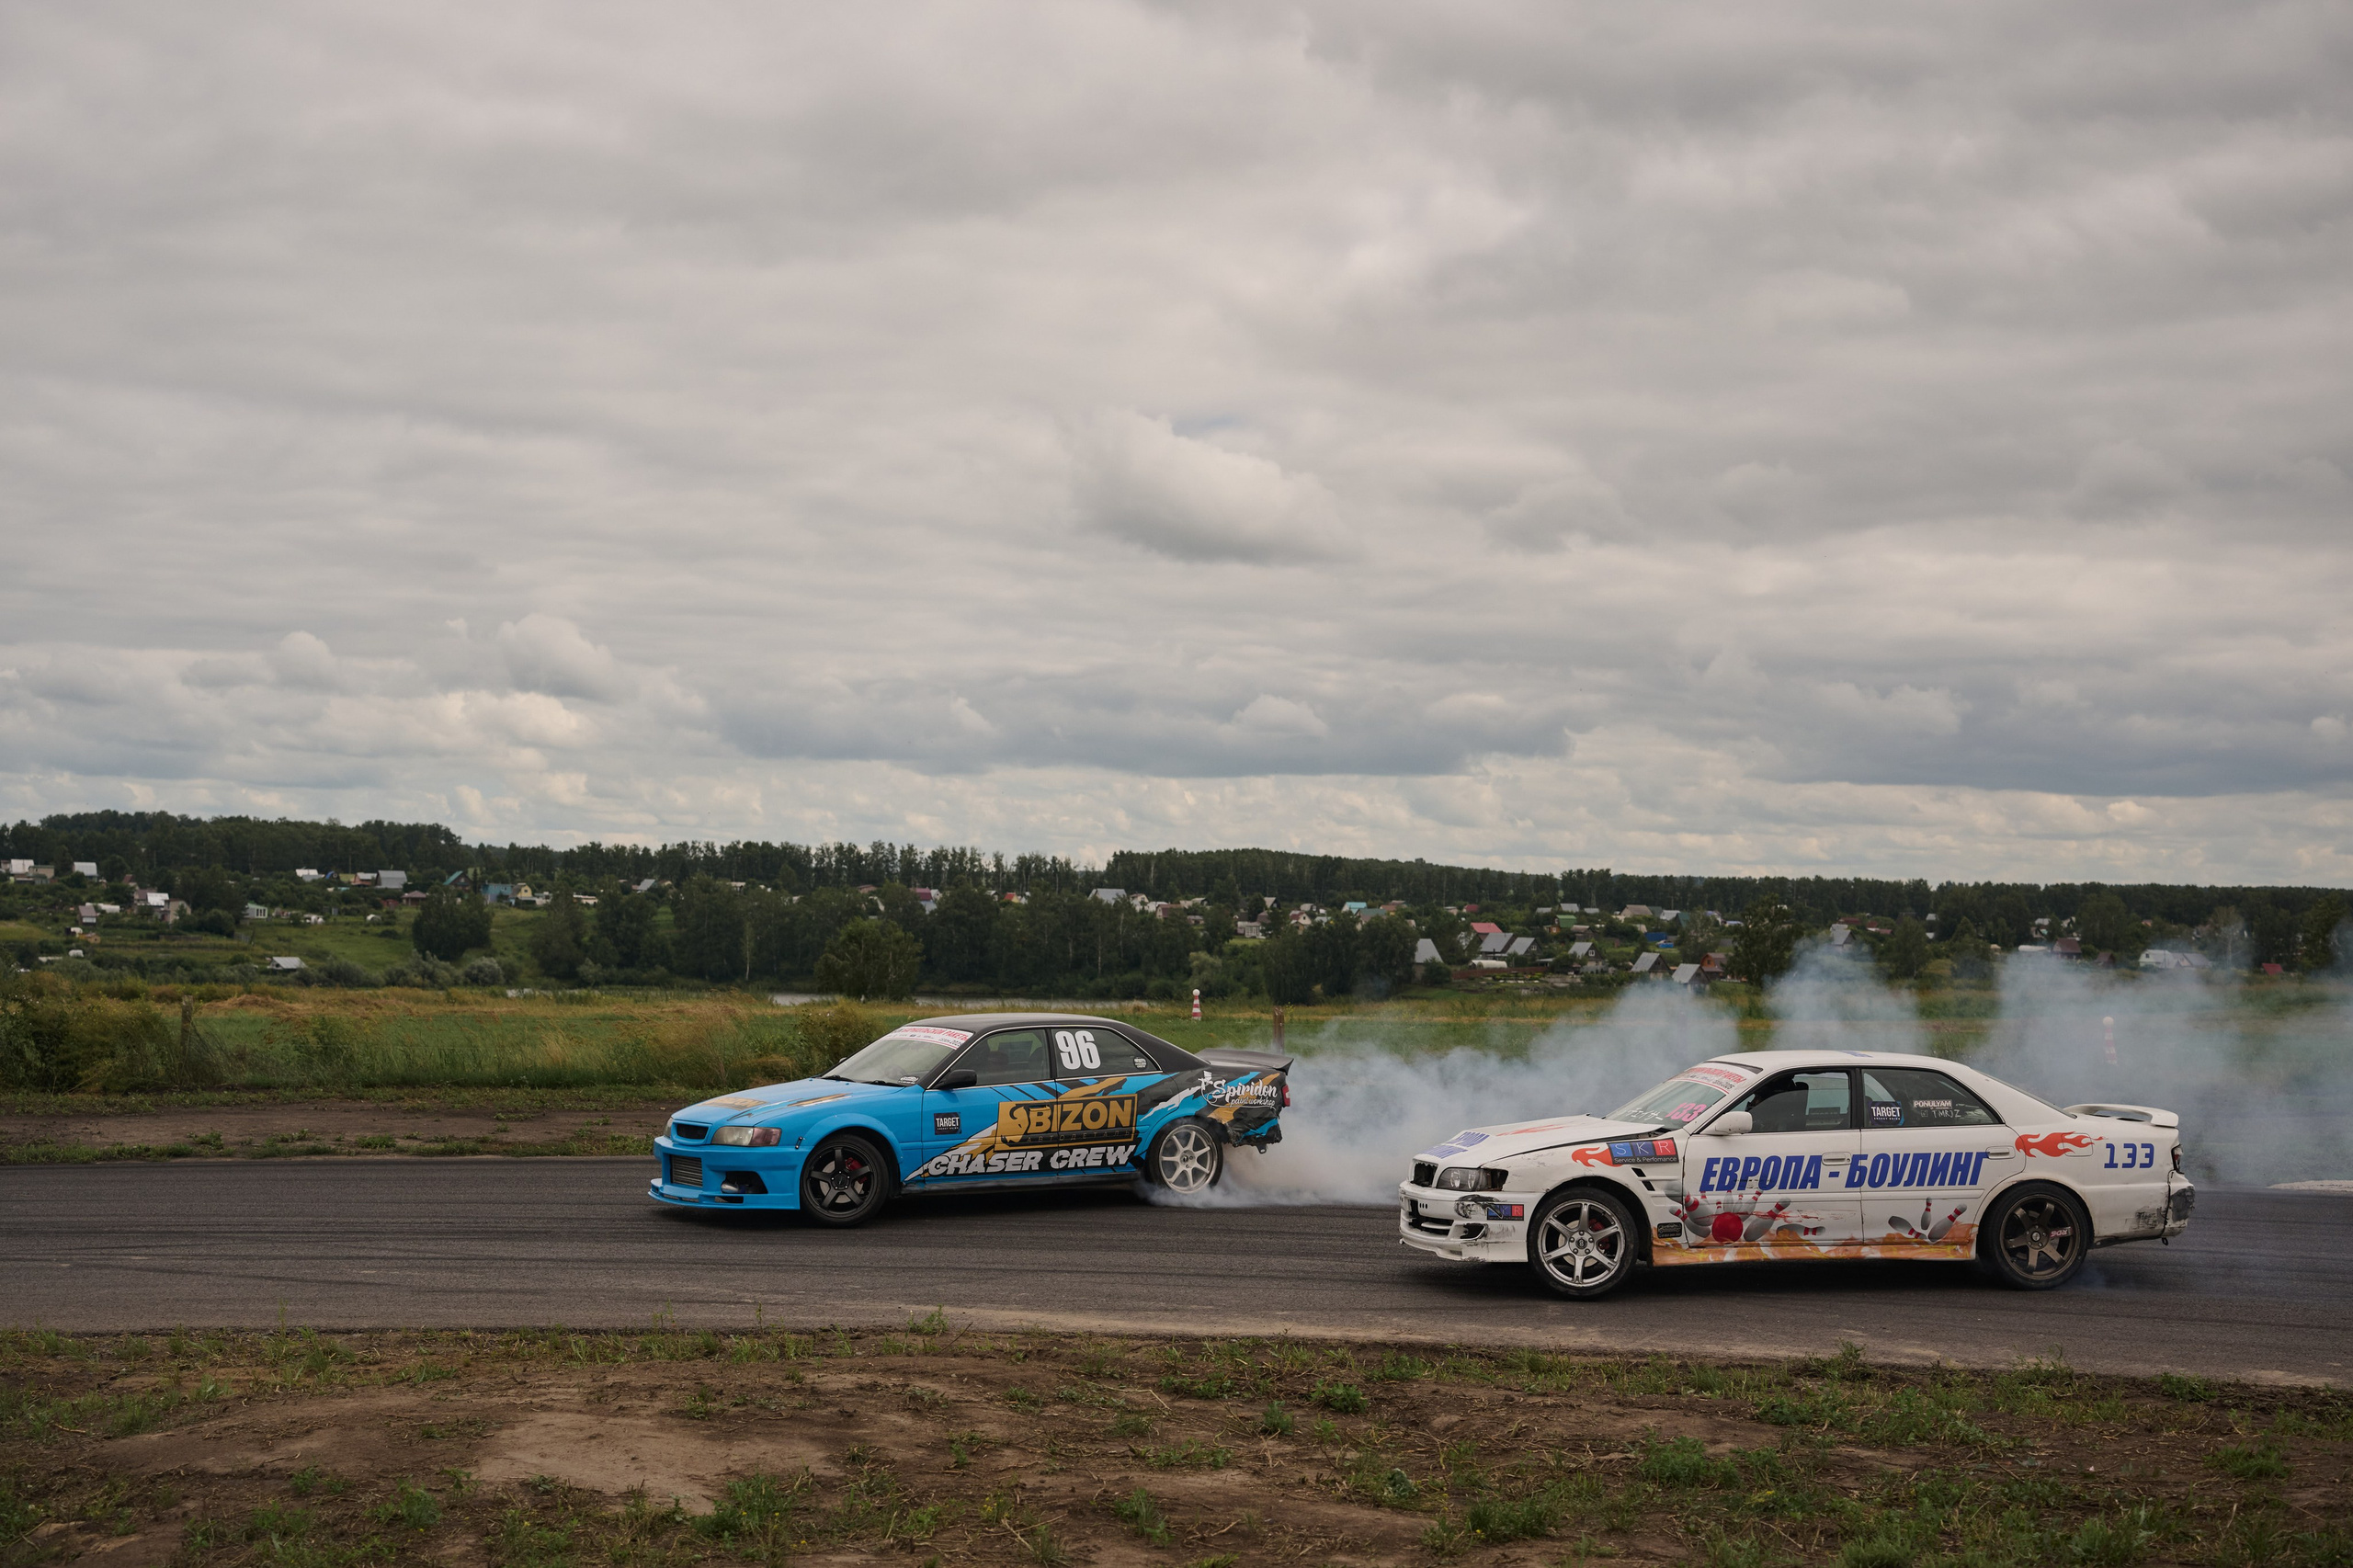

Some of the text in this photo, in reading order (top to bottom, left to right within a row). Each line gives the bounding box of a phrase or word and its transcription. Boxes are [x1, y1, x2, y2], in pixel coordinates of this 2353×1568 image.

[1055, 1030, 1101, 1070] 96
[1212, 1079, 1278, 1103] Spiridon
[936, 1117, 960, 1128] TARGET
[1027, 1099, 1132, 1134] BIZON
[1665, 1103, 1707, 1122] 133
[1870, 1107, 1901, 1118] TARGET
[927, 1145, 1136, 1176] CHASER CREW
[1615, 1141, 1671, 1155] SKR
[2104, 1142, 2154, 1168] 133
[1699, 1154, 1823, 1192] ЕВРОПА
[1845, 1152, 1990, 1188] БОУЛИНГ
